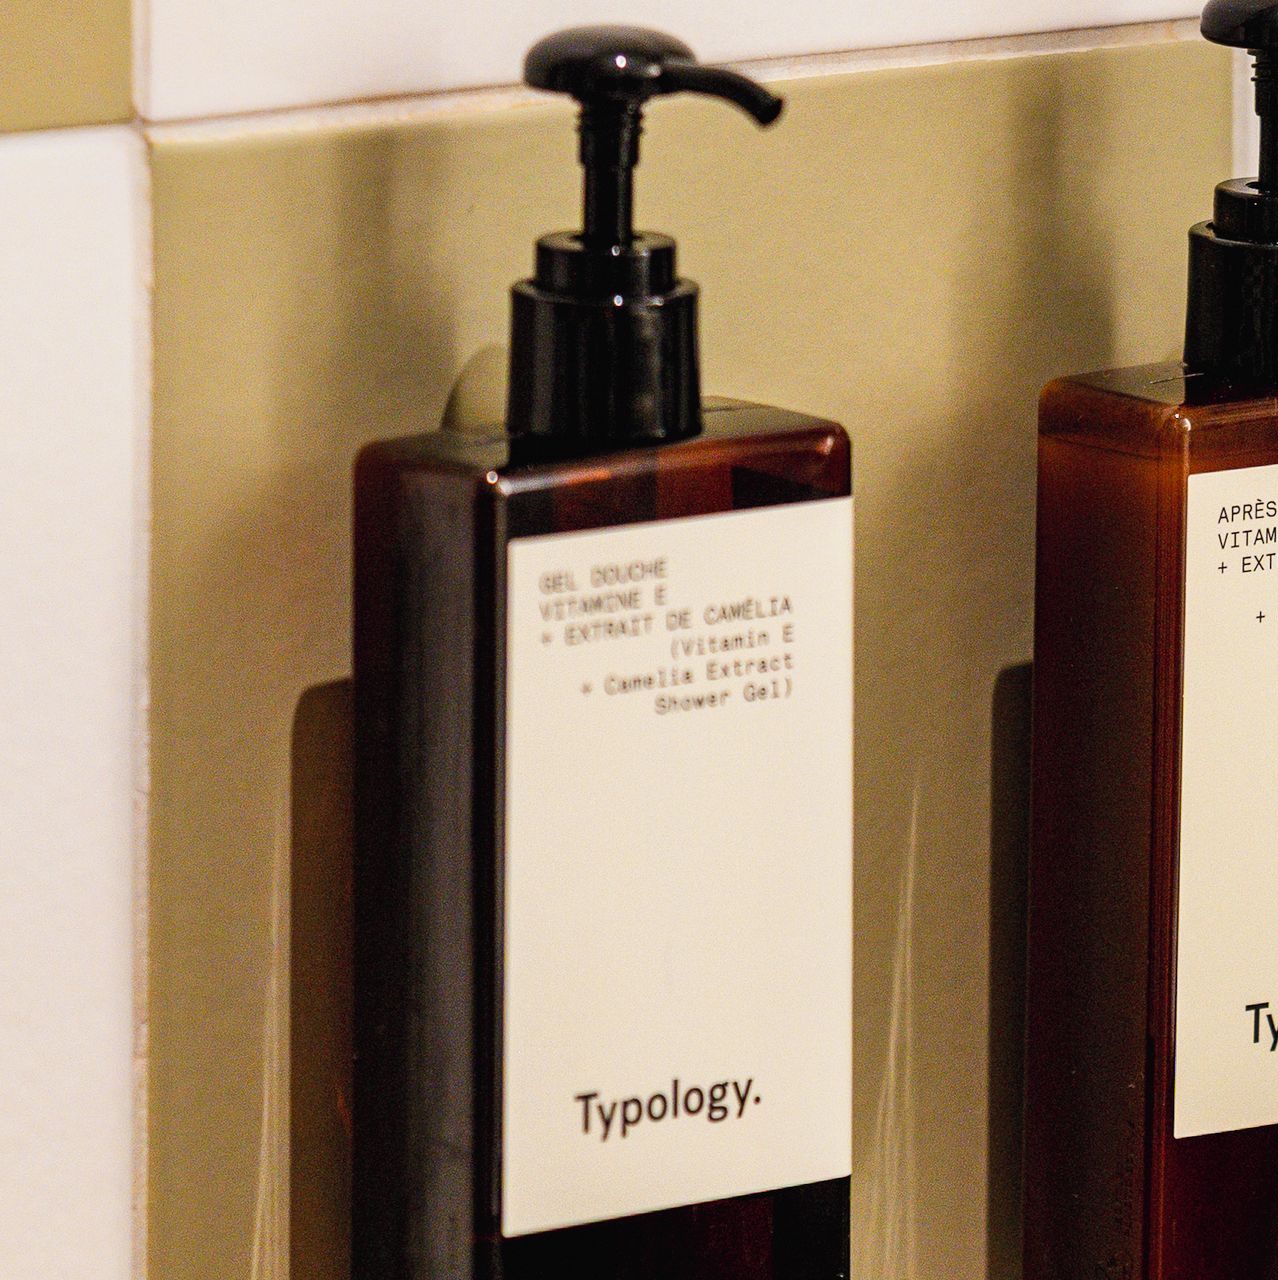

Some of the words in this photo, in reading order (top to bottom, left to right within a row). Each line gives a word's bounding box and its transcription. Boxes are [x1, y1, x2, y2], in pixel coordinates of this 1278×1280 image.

[538, 568, 577, 595] GEL
[590, 556, 669, 588] DOUCHE
[1218, 561, 1228, 574] +
[539, 591, 640, 622] VITAMINE
[654, 585, 668, 607] E
[564, 613, 654, 646] EXTRAIT
[665, 608, 692, 631] DE
[703, 595, 792, 626] CAMÉLIA
[1256, 610, 1266, 623] +
[782, 622, 795, 643] E
[604, 667, 694, 696] Camelia
[706, 653, 794, 681] Extract
[654, 689, 730, 716] Shower
[574, 1078, 761, 1142] Typology.
